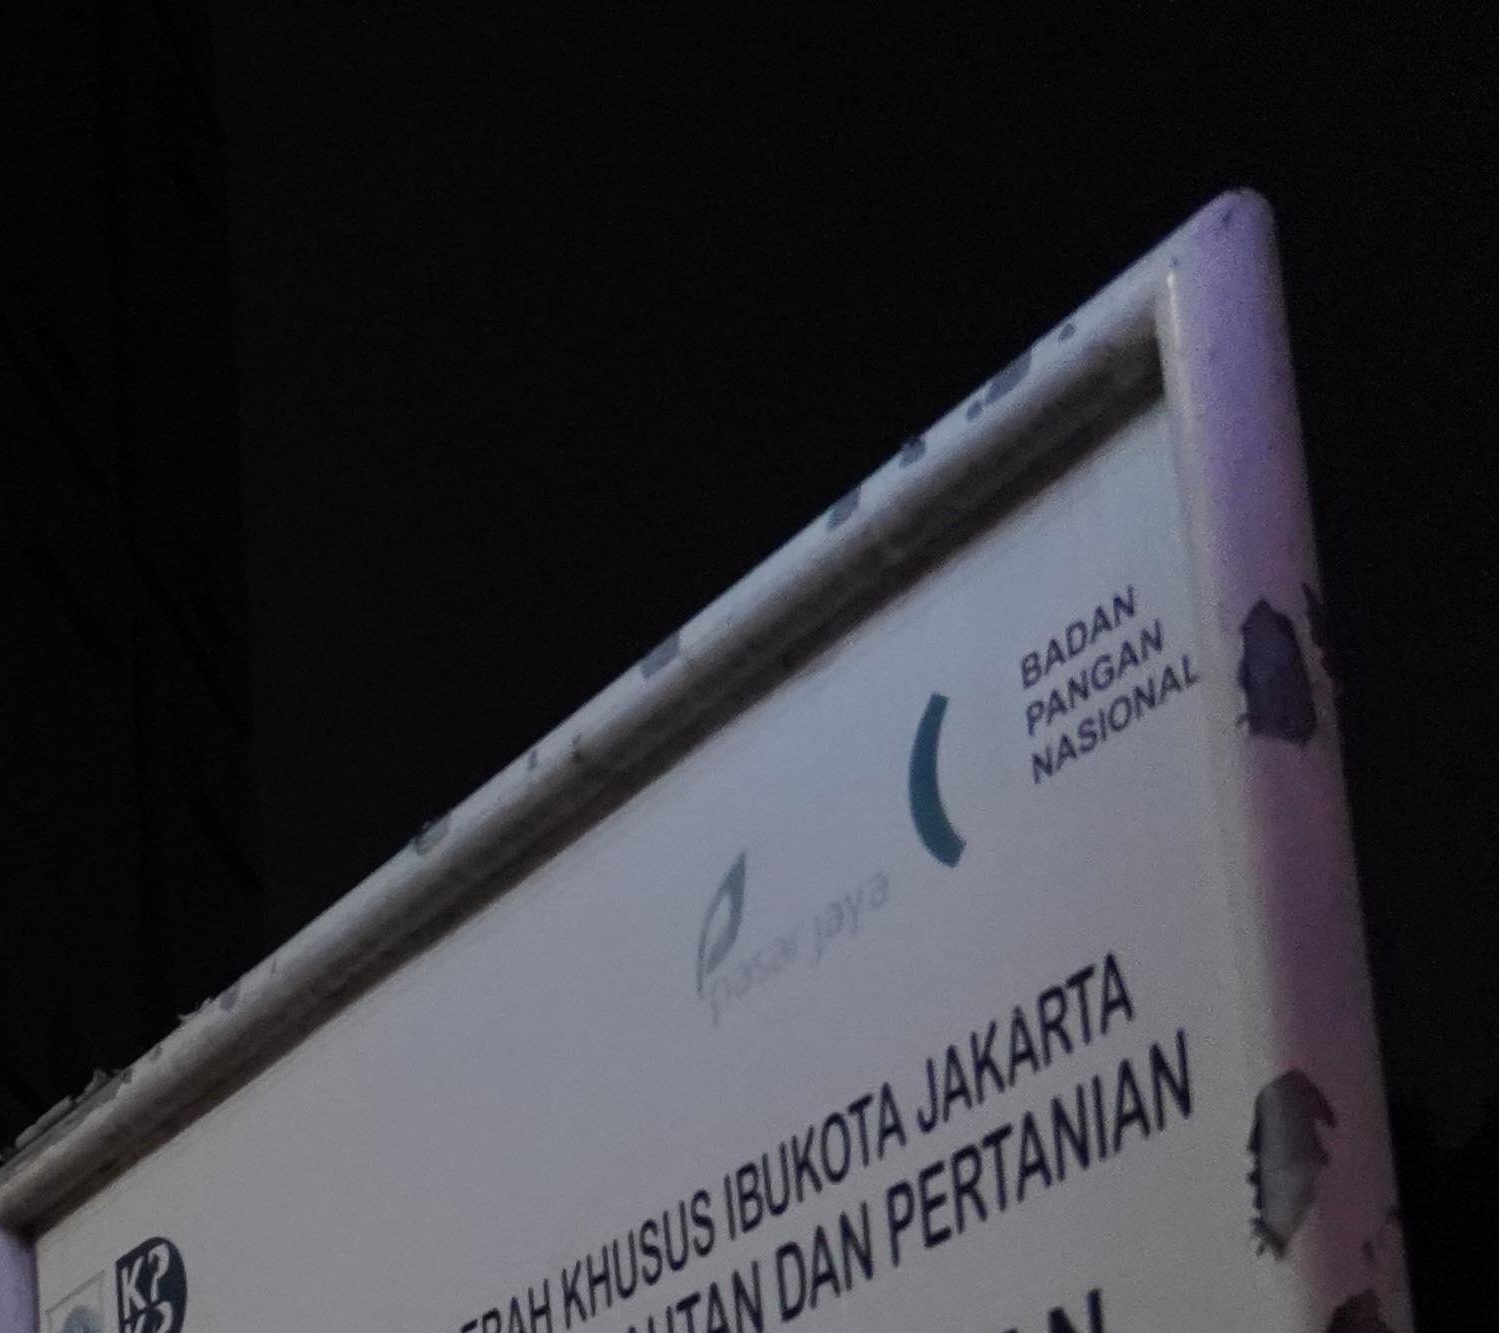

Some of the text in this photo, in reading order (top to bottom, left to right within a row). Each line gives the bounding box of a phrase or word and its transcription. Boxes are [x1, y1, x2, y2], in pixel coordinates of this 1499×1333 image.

[1020, 586, 1136, 688] BADAN
[1027, 619, 1163, 735] PANGAN
[1031, 654, 1200, 784] NASIONAL
[707, 869, 889, 1026] pasar jaya
[725, 1083, 906, 1241] IBUKOTA
[917, 952, 1135, 1136] JAKARTA
[776, 1202, 875, 1323] DAN
[887, 1029, 1194, 1266] PERTANIAN
